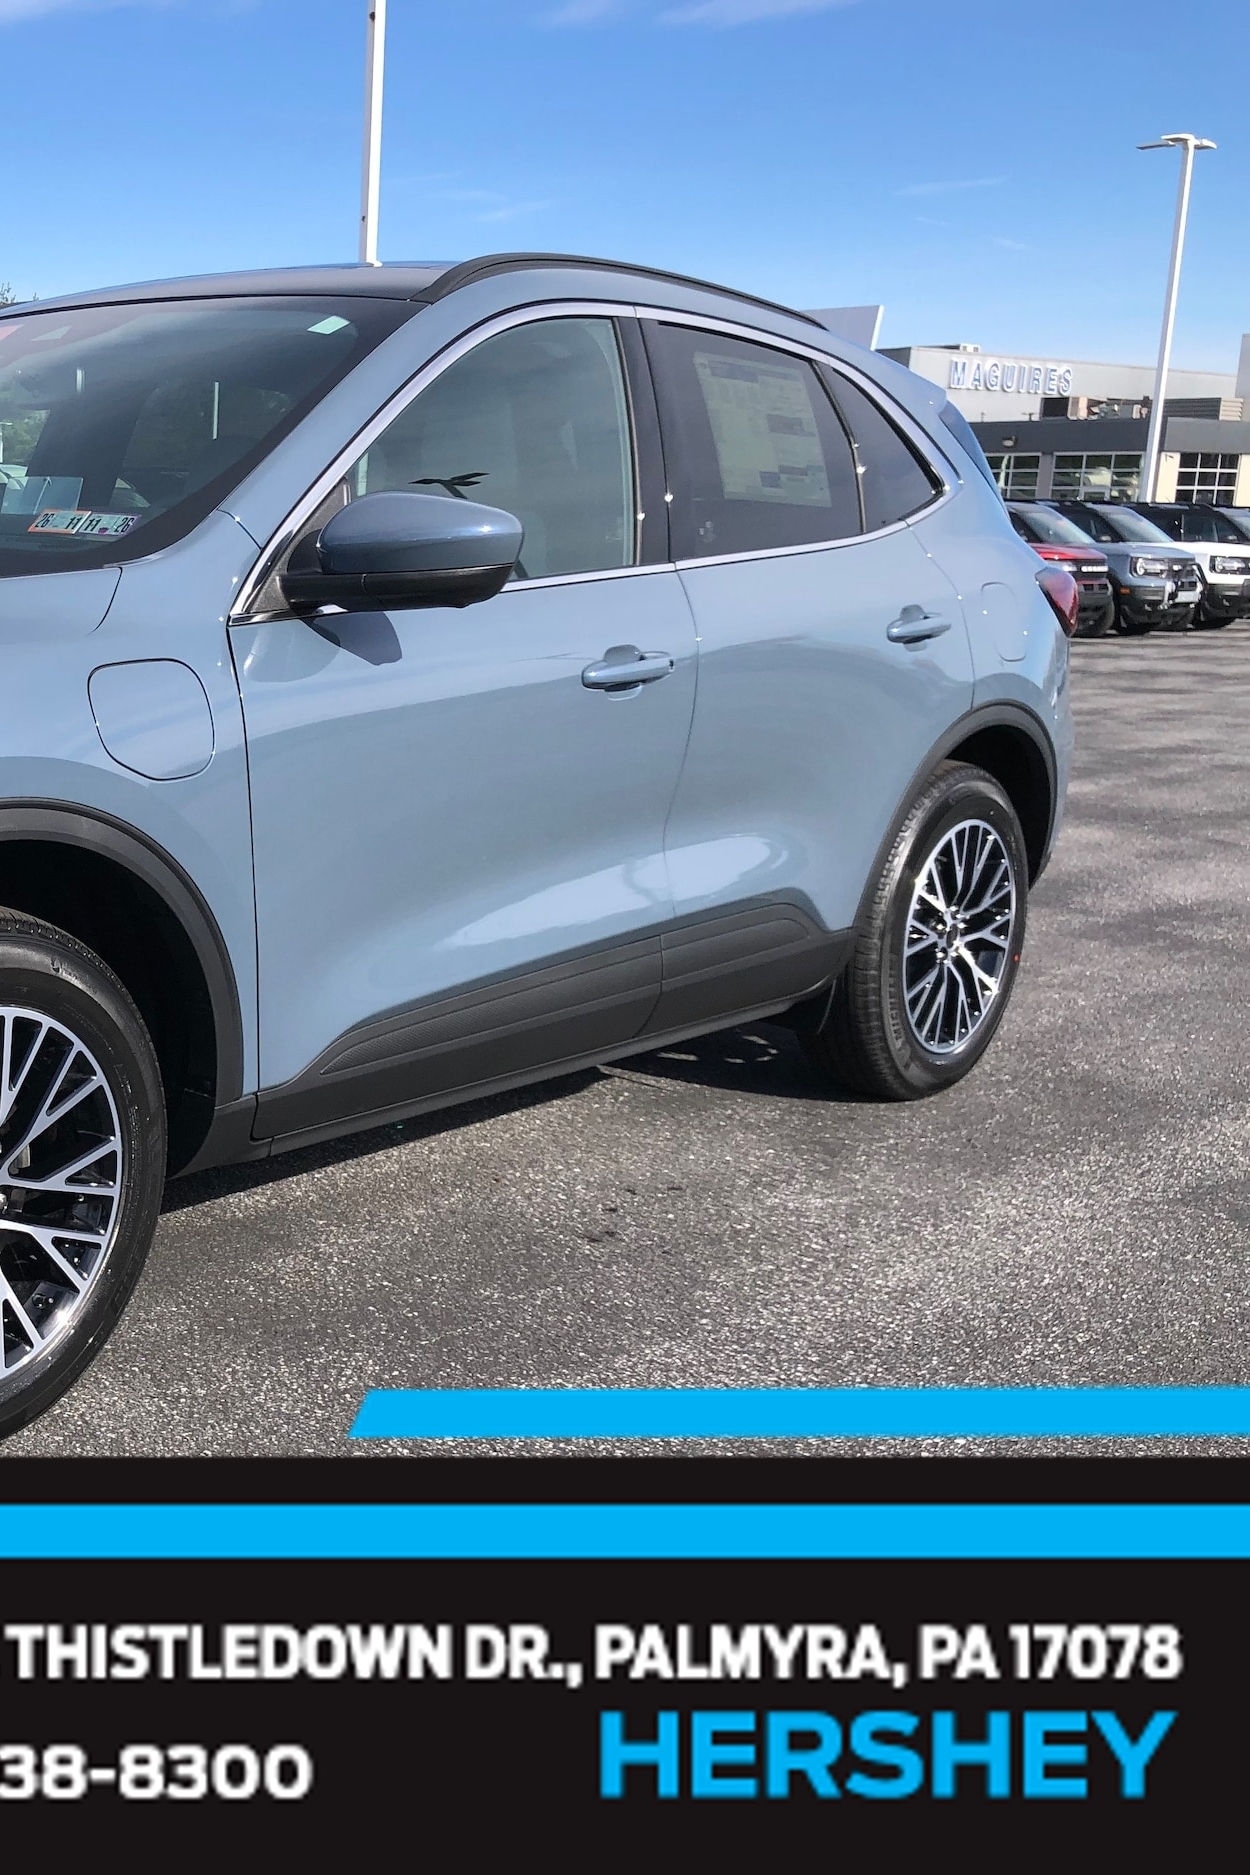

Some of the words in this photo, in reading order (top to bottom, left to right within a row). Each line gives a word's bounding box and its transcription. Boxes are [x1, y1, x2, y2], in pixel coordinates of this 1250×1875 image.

[950, 358, 1072, 396] MAGUIRES
[34, 512, 55, 528] 26
[114, 516, 135, 533] 26
